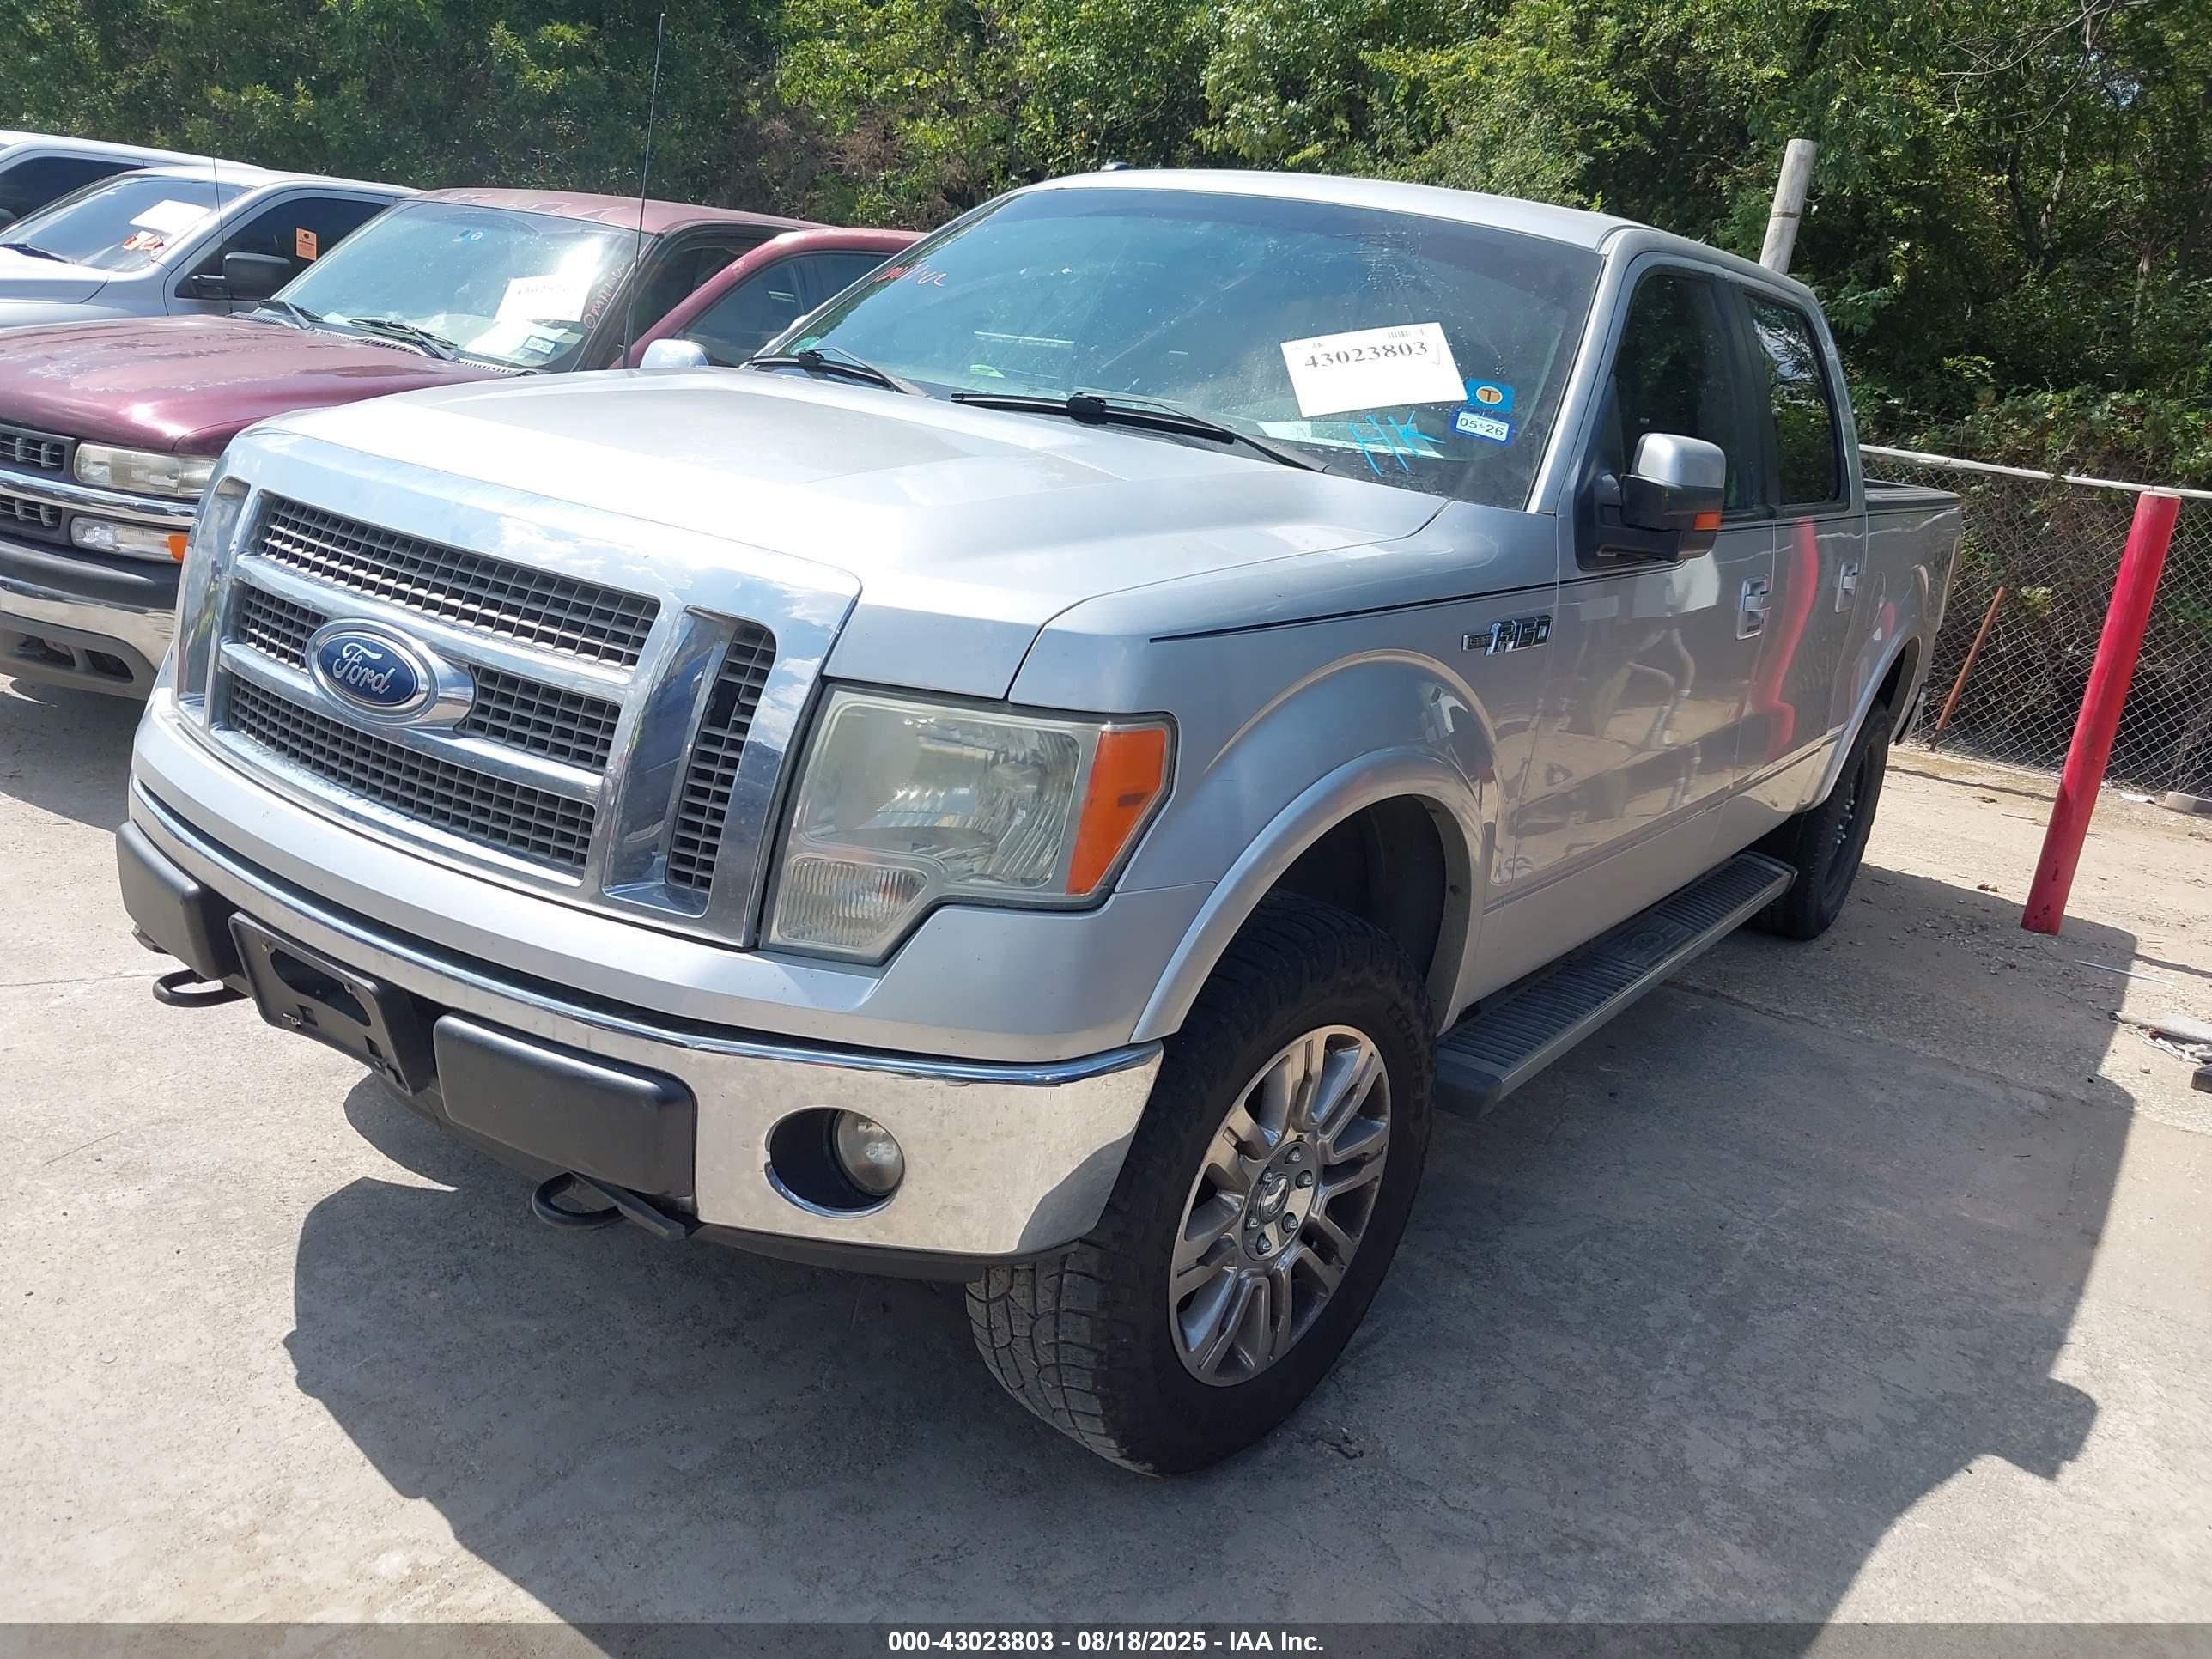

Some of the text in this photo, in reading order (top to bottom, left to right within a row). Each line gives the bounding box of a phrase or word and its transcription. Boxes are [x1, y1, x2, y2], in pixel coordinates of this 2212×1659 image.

[1304, 341, 1428, 368] 43023803
[1481, 388, 1498, 403] T
[332, 642, 396, 695] Ford
